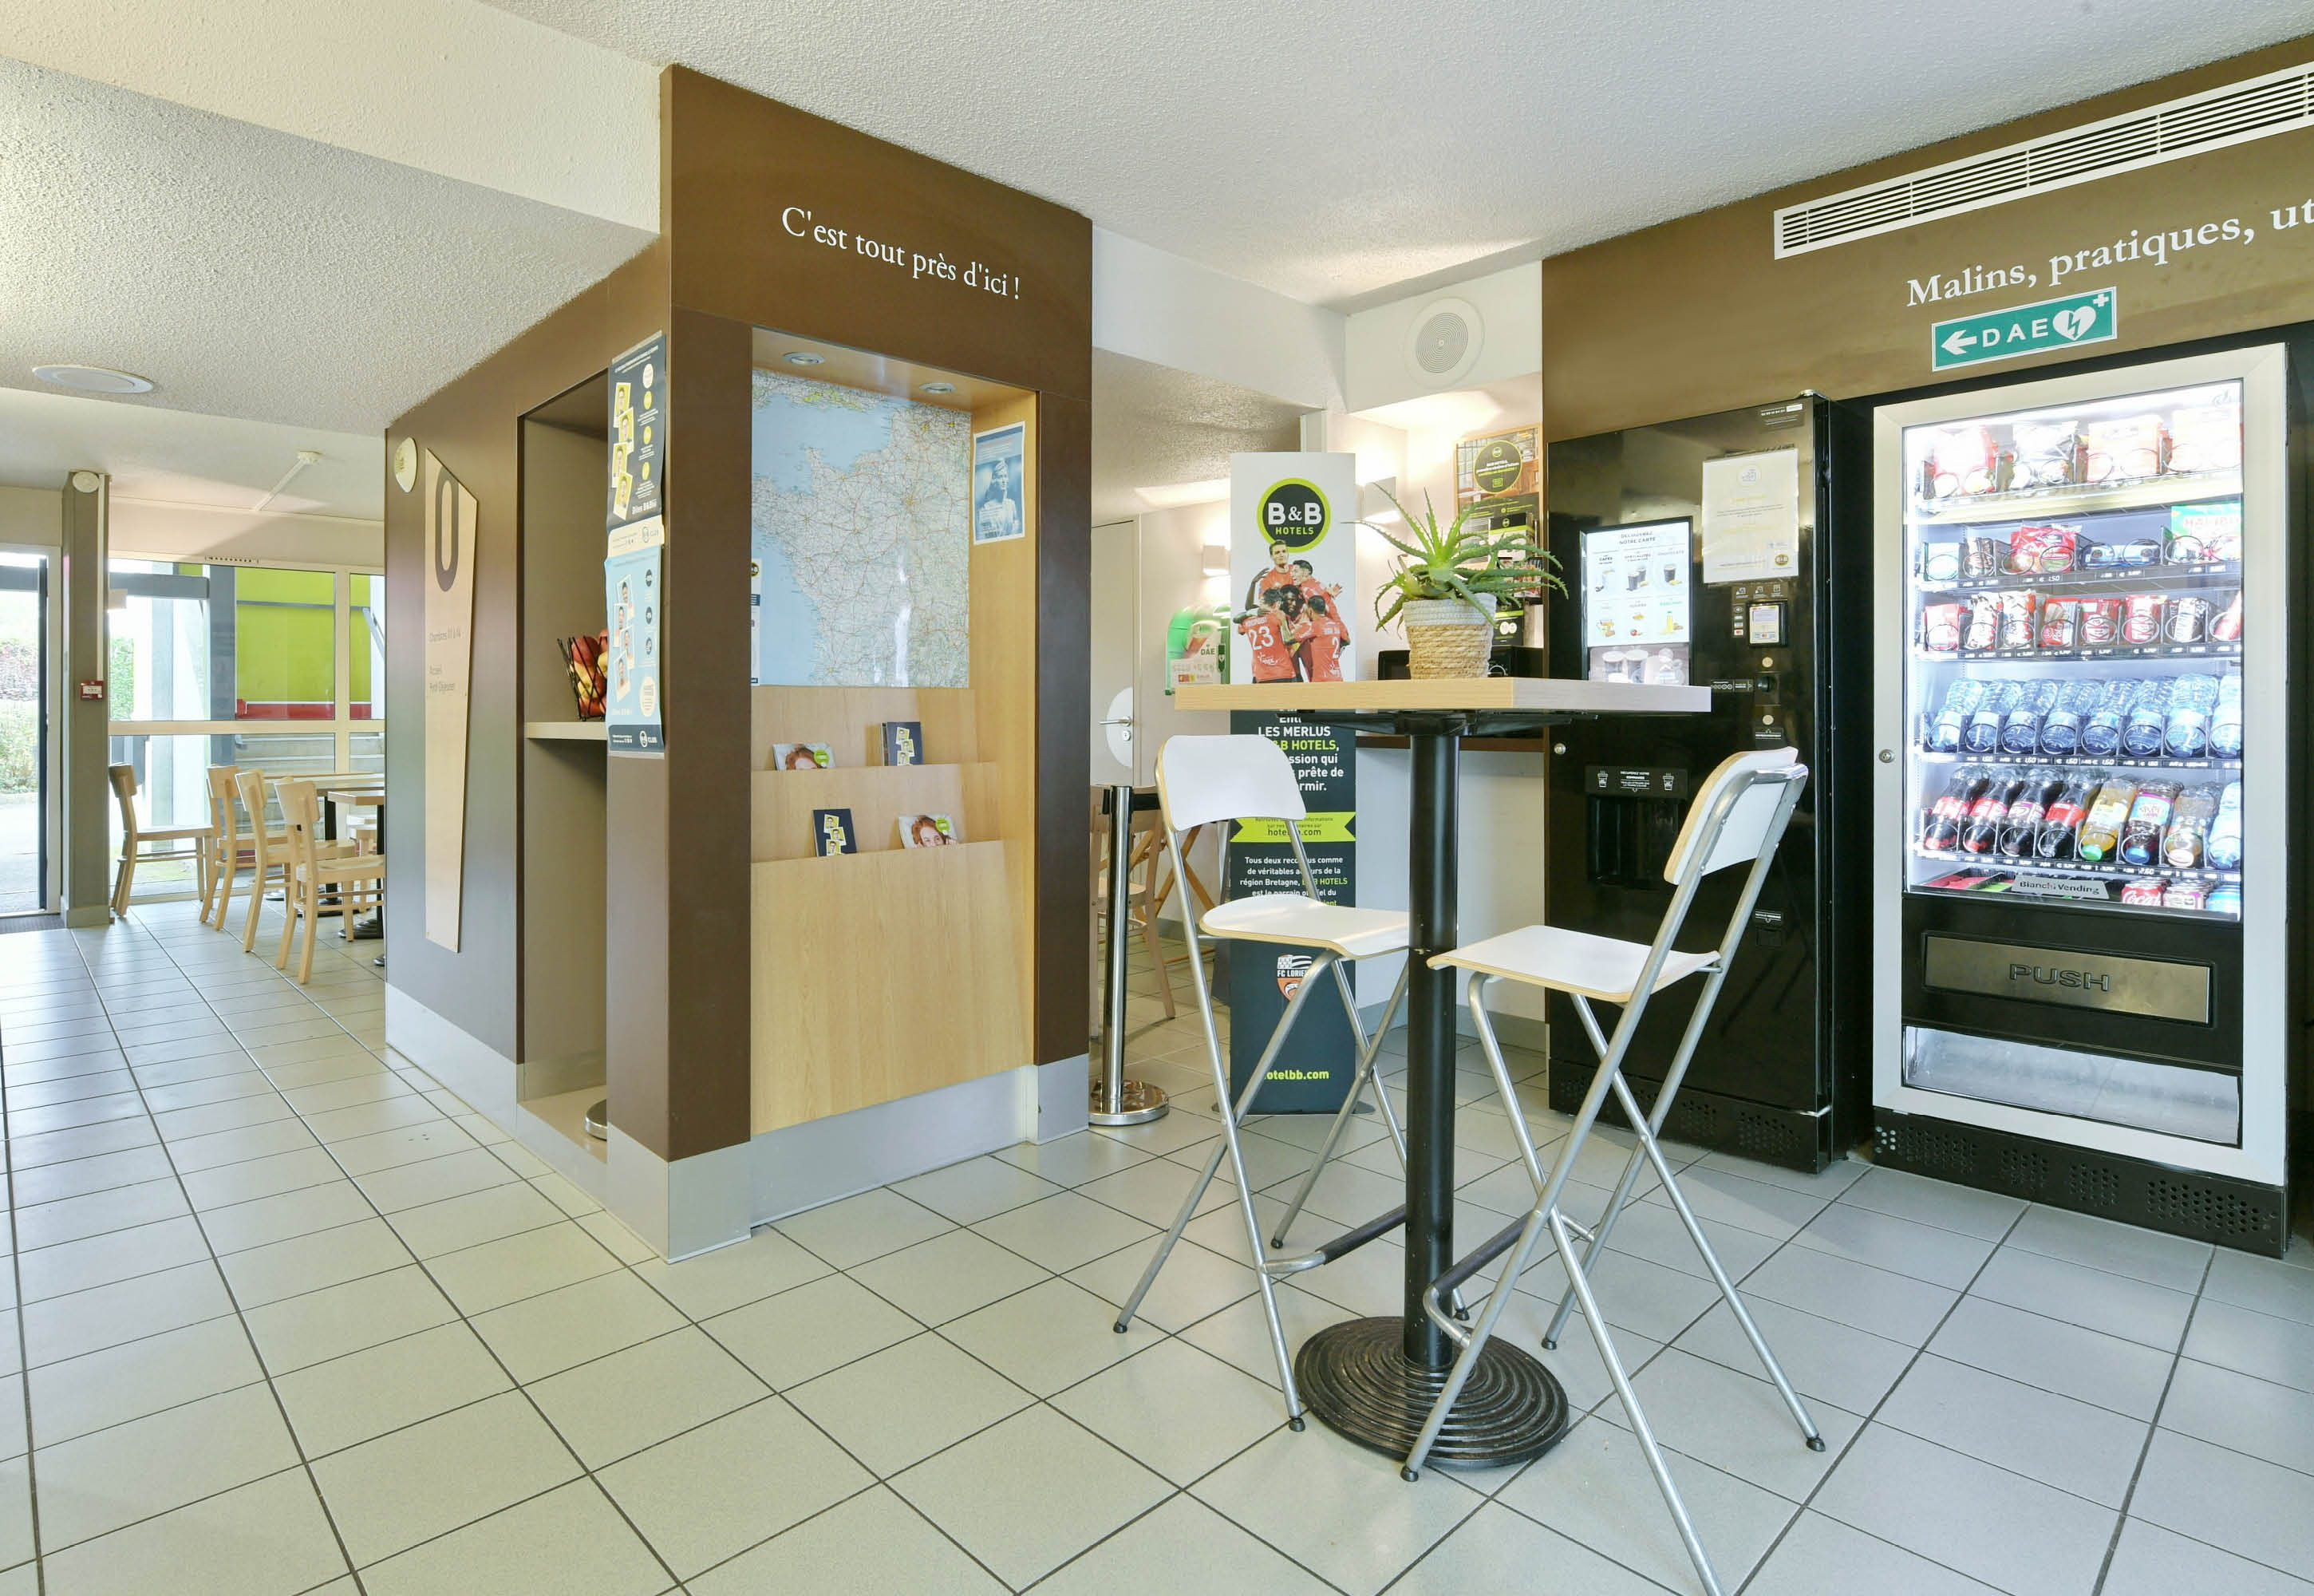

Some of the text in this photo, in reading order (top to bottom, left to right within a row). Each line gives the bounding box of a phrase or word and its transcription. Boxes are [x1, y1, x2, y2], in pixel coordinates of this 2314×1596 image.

[781, 207, 847, 250] C'est
[855, 235, 906, 267] tout
[912, 252, 957, 281] près
[963, 261, 1008, 296] d'ici
[1905, 263, 2037, 307] Malins,
[2048, 217, 2255, 286] pratiques,
[1982, 318, 2049, 348] DAE
[1267, 502, 1322, 525] B&B
[1275, 527, 1314, 535] HOTELS
[1248, 626, 1274, 650] 23
[1258, 726, 1331, 737] LES MERLUS
[1291, 740, 1340, 752] HOTELS,
[1289, 753, 1338, 766] ssion qui
[1298, 766, 1345, 780] prête de
[1299, 780, 1327, 792] rmir.
[2058, 883, 2100, 895] Vending
[2008, 963, 2111, 992] PUSH
[1265, 1070, 1329, 1080] otelbb.com
